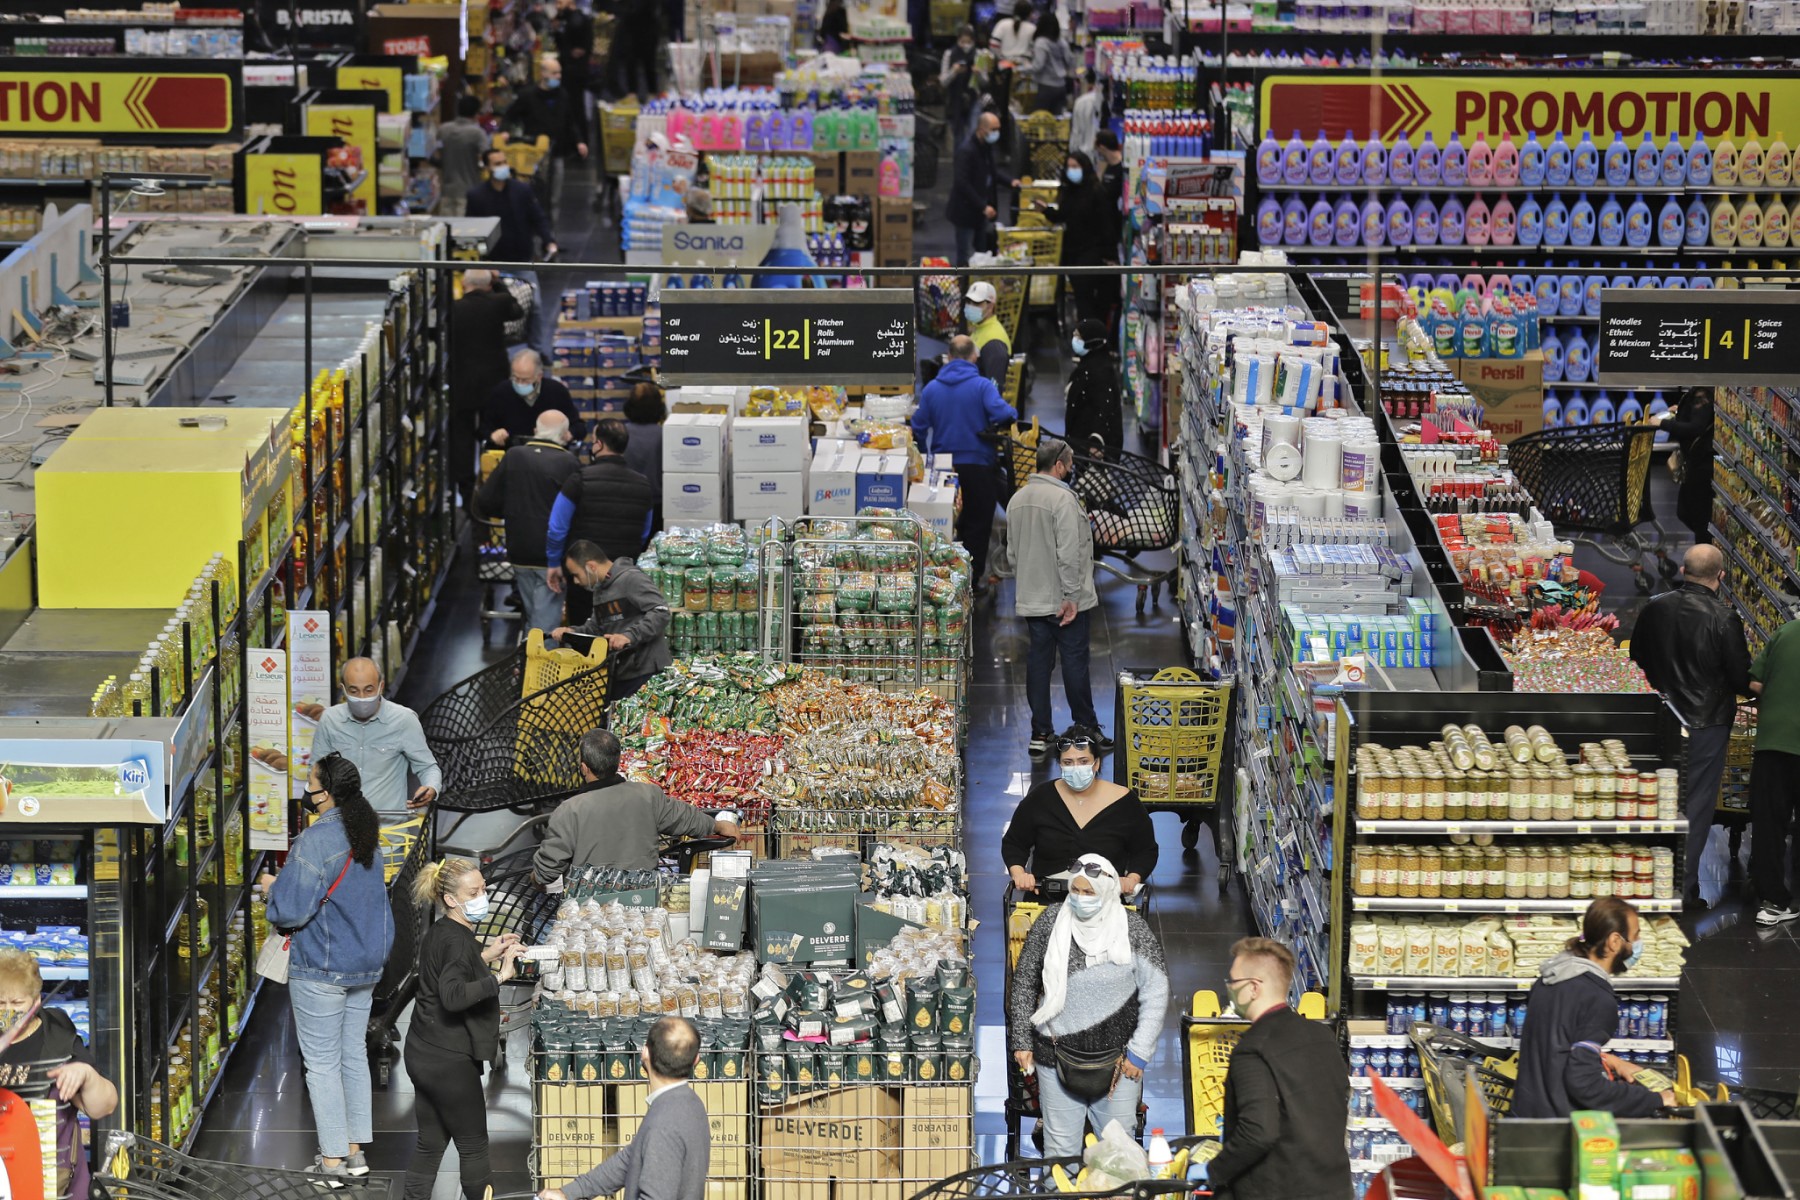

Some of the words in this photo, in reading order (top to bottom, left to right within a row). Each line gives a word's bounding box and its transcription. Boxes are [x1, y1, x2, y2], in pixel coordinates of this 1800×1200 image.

[1455, 91, 1770, 137] PROMOTION
[674, 231, 744, 250] Sanita
[742, 320, 757, 328] زيت
[890, 319, 904, 328] رول
[1758, 320, 1782, 328] Spices
[719, 334, 740, 343] زيتون
[742, 334, 757, 342] زيت
[773, 330, 800, 349] 22
[877, 330, 904, 339] للمطبخ
[1720, 330, 1734, 349] 4
[1757, 330, 1778, 339] Soup
[889, 338, 904, 348] ورق
[818, 348, 830, 356] Foil
[1482, 366, 1524, 380] Persil
[1482, 420, 1522, 434] Persil
[815, 488, 851, 502] BRUMI
[123, 769, 145, 784] Kiri
[810, 935, 850, 944] DELVERDE
[1356, 944, 1376, 954] BiO
[1384, 947, 1402, 956] BiO
[1410, 945, 1430, 955] BiO
[1438, 946, 1457, 956] BiO
[1465, 945, 1484, 954] BiO
[1492, 948, 1510, 958] BiO
[775, 1118, 862, 1141] DELVERDE
[912, 1124, 958, 1132] DELVERDE
[549, 1133, 595, 1141] DELVERDE
